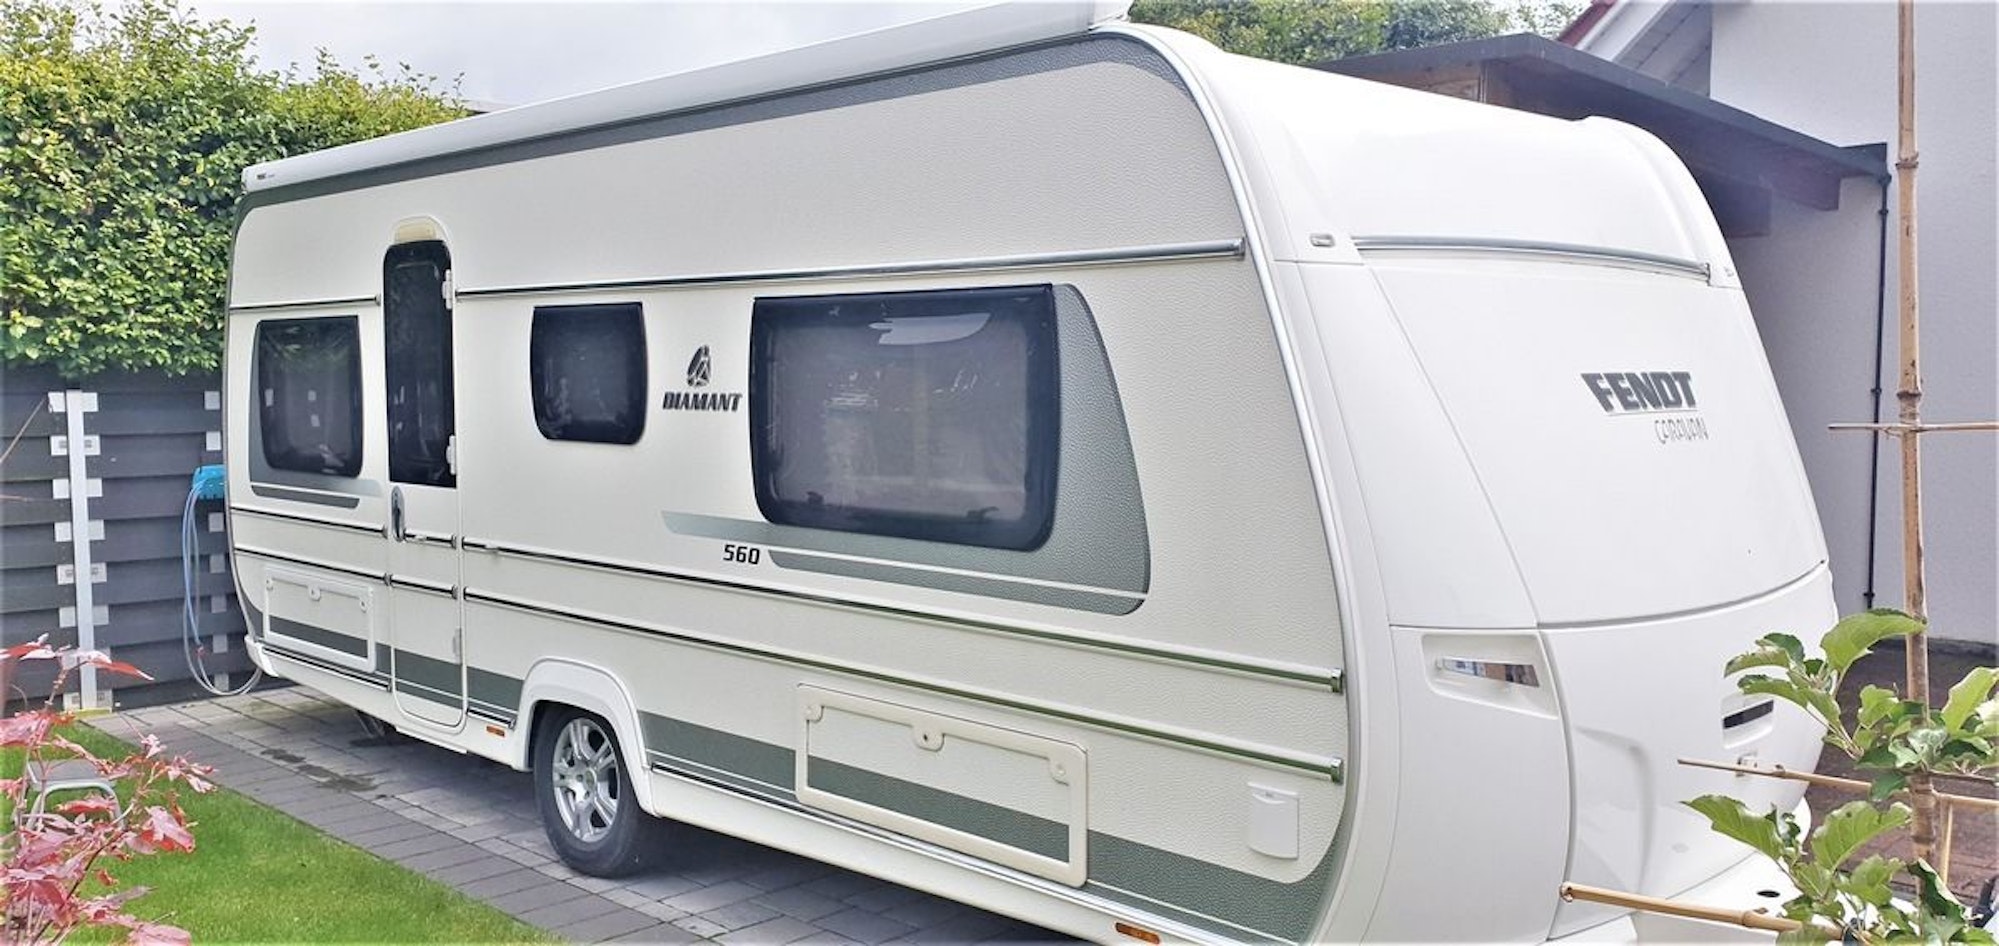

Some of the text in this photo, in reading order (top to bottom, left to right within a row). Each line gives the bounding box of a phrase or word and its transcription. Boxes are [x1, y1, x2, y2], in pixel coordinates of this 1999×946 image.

[662, 392, 742, 412] DIAMANT
[1580, 371, 1697, 412] FENDT
[1654, 418, 1709, 445] CARAVAN
[723, 544, 760, 565] 560
